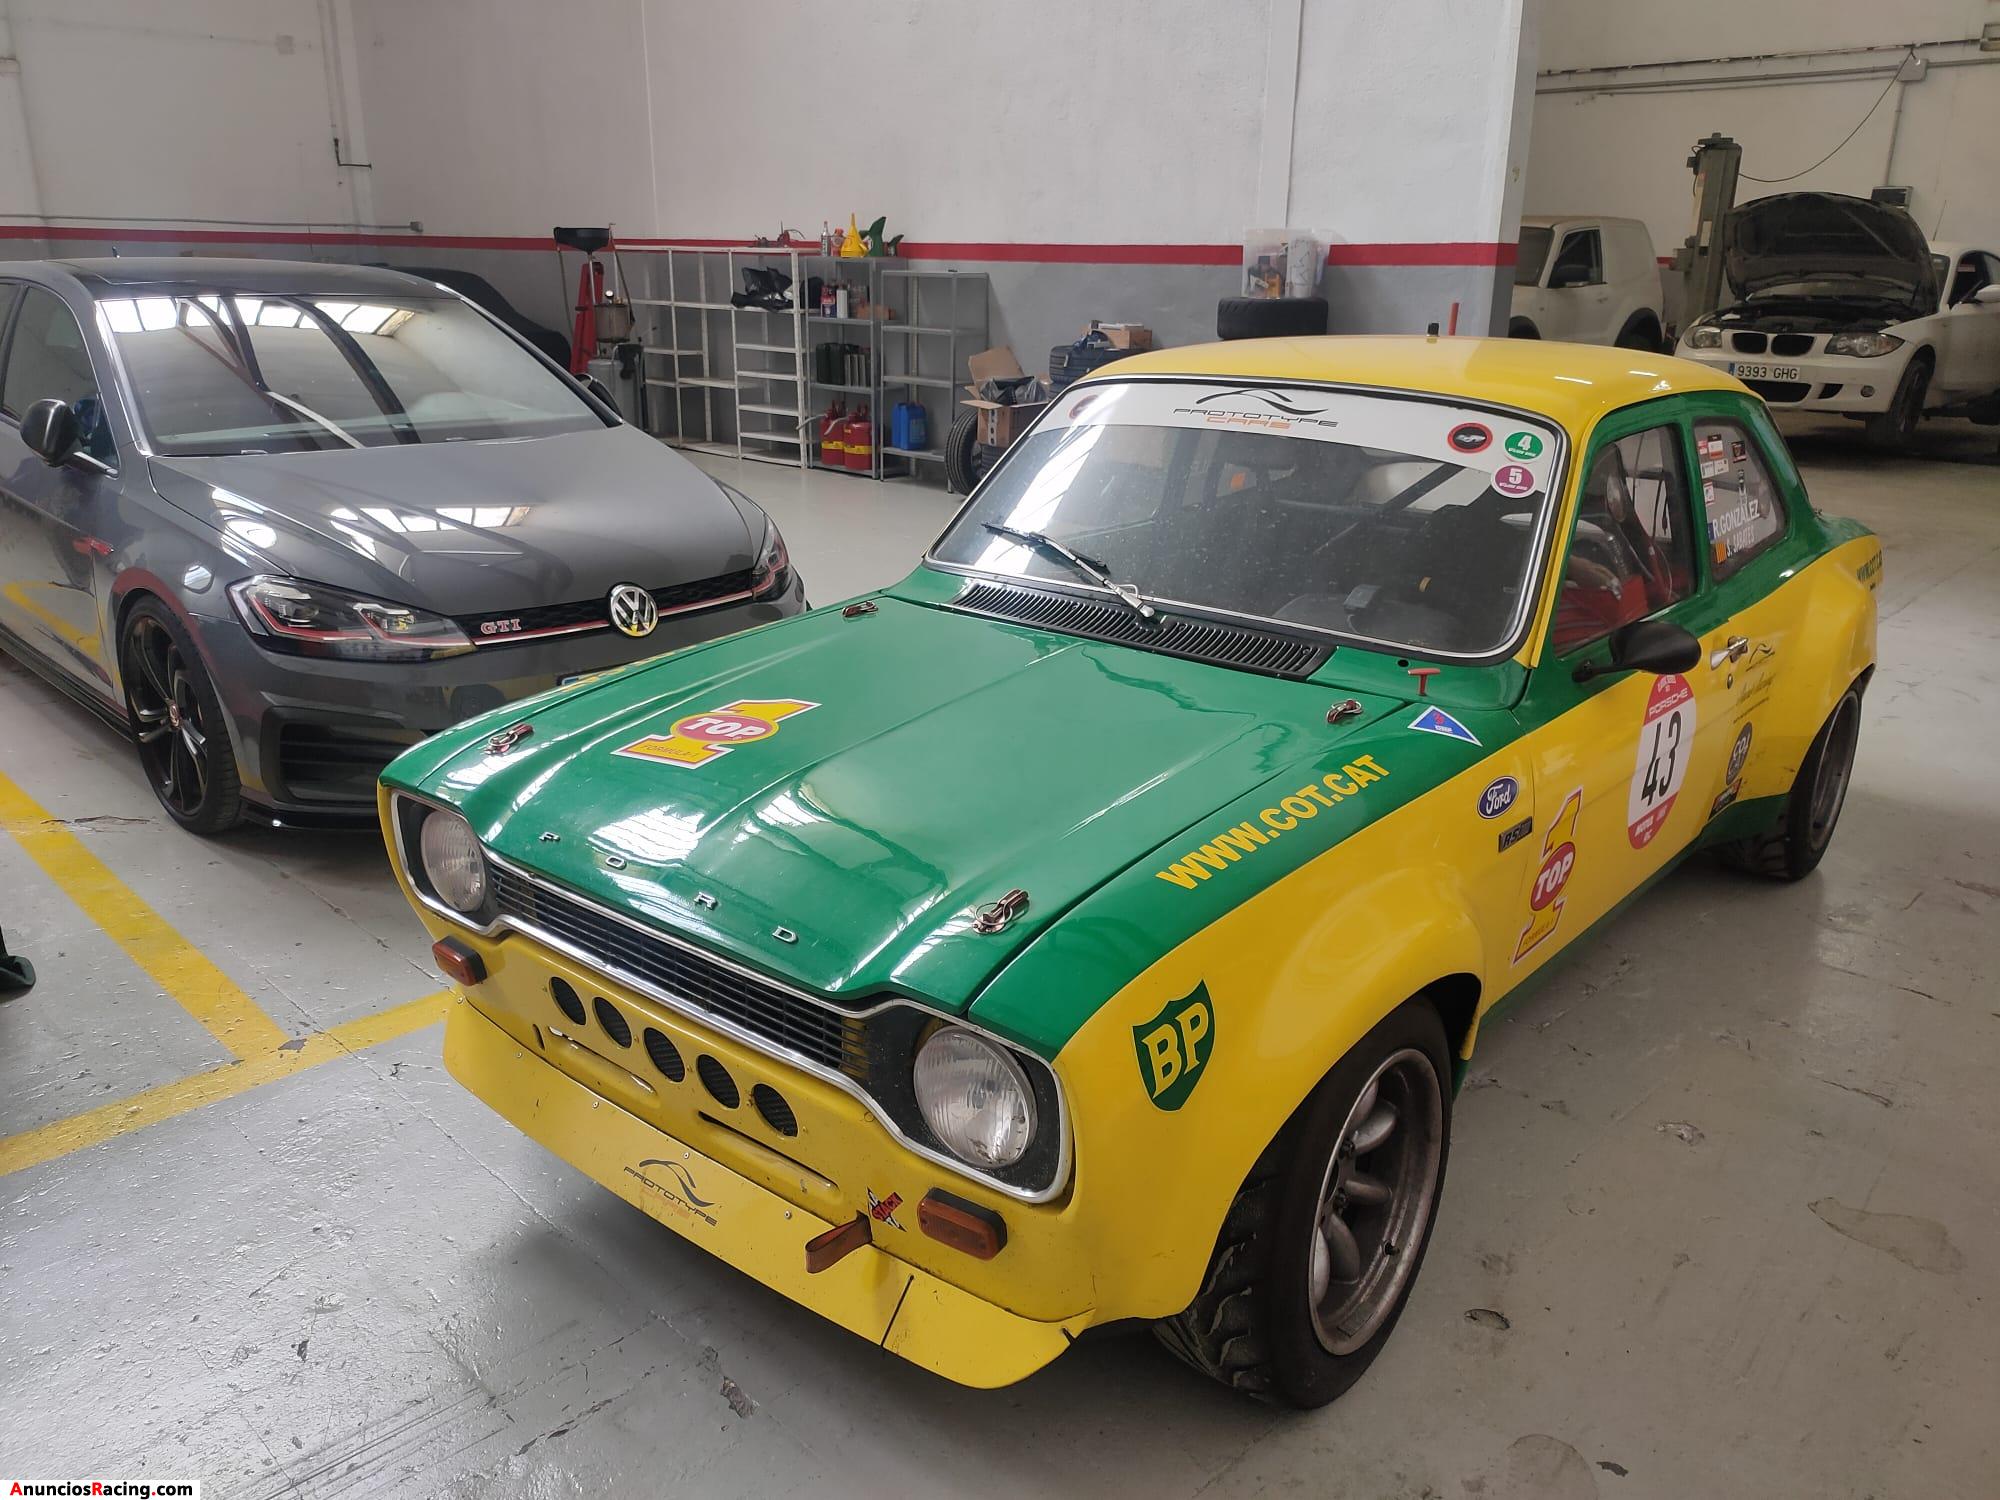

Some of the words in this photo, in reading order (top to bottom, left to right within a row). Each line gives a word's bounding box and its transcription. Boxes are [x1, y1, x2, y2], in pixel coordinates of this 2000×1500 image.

[1737, 365, 1767, 378] 9393
[1773, 367, 1798, 380] GHG
[1173, 408, 1338, 428] PROTOTYPE
[1518, 435, 1532, 451] 4
[1509, 468, 1522, 485] 5
[480, 618, 522, 635] GTI
[1648, 687, 1689, 717] PORSCHE
[684, 717, 766, 739] TOP
[1641, 711, 1682, 806] 43
[1485, 783, 1512, 815] Ford
[1155, 754, 1390, 890] WWW.COT.CAT
[1534, 850, 1574, 904] TOP
[1141, 1002, 1209, 1100] BP
[623, 1166, 718, 1227] PROTOTYPE
